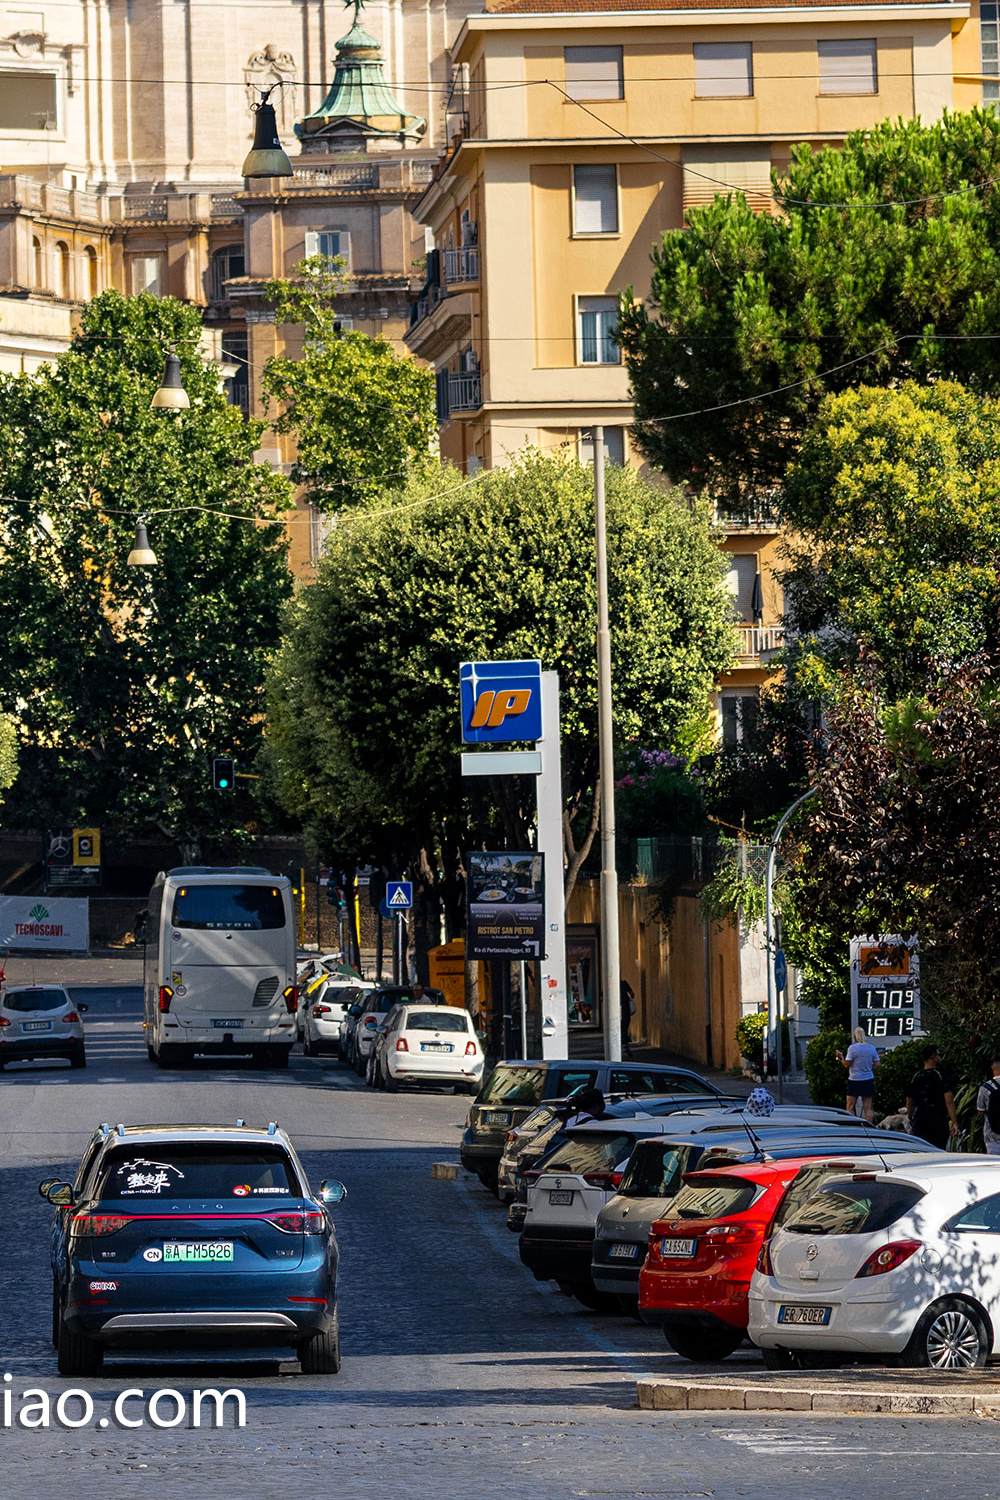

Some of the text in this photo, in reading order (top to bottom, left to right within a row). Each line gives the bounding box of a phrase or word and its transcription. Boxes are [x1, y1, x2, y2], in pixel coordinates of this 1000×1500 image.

[471, 689, 531, 727] IP
[15, 924, 63, 936] TECNOSCAVI
[501, 927, 513, 935] SAN
[147, 1251, 160, 1259] CN
[90, 1282, 116, 1290] CHINA
